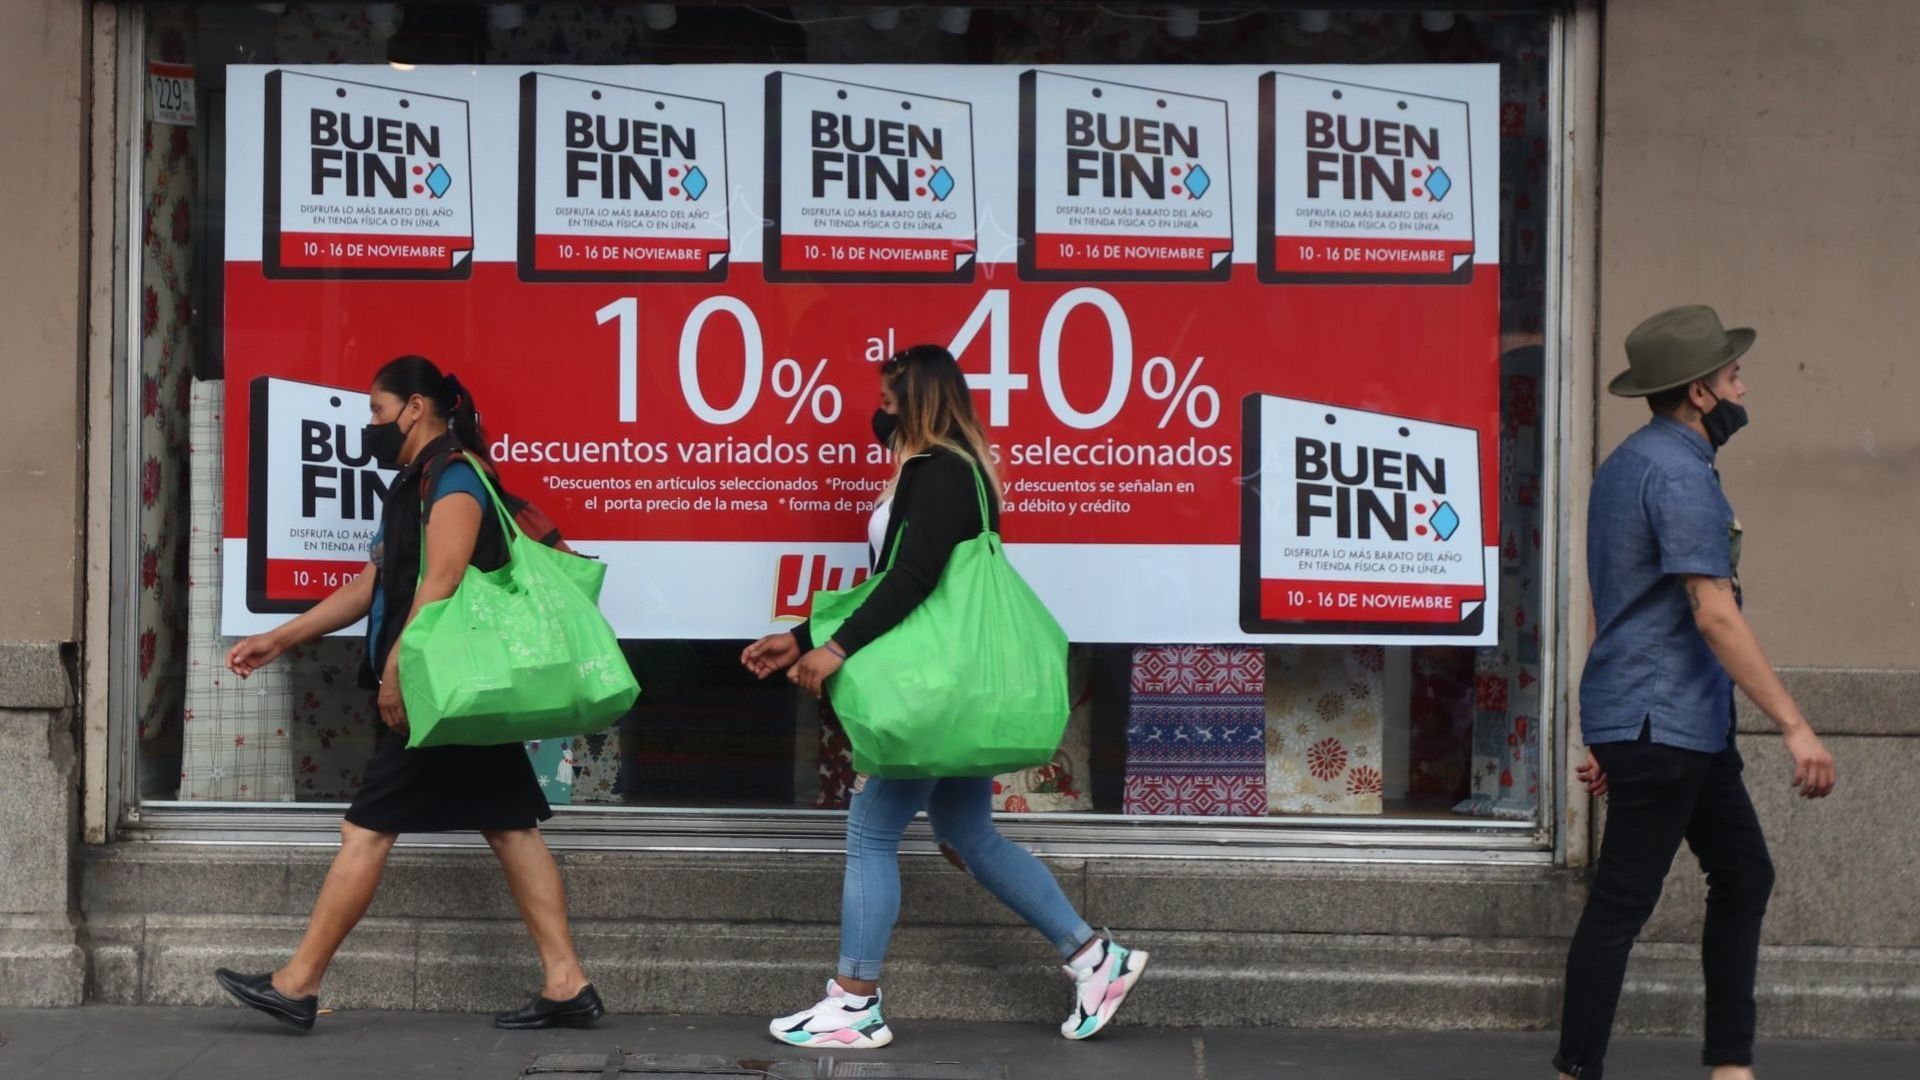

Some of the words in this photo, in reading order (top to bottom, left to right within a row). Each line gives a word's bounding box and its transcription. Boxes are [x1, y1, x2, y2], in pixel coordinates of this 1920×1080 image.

[311, 108, 440, 158] BUEN
[566, 110, 695, 160] BUEN
[812, 110, 942, 160] BUEN
[1067, 108, 1198, 158] BUEN
[1306, 110, 1439, 160] BUEN
[311, 148, 406, 198] FIN
[566, 150, 662, 201] FIN
[812, 150, 909, 201] FIN
[1067, 148, 1164, 199] FIN
[1307, 150, 1405, 202] FIN
[301, 205, 339, 214] DISFRUTA
[343, 206, 353, 214] LO
[356, 205, 376, 215] MÁS
[379, 207, 412, 216] BARATO
[415, 208, 429, 216] DEL
[432, 207, 453, 217] AÑO
[556, 208, 594, 216] DISFRUTA
[598, 209, 608, 217] LO
[612, 207, 631, 217] MÁS
[634, 209, 668, 218] BARATO
[671, 210, 685, 219] DEL
[688, 209, 709, 219] AÑO
[802, 208, 840, 217] DISFRUTA
[844, 209, 855, 217] LO
[858, 207, 878, 218] MÁS
[881, 210, 914, 219] BARATO
[918, 211, 932, 219] DEL
[935, 210, 956, 220] AÑO
[1056, 206, 1095, 215] DISFRUTA
[1099, 207, 1110, 215] LO
[1113, 206, 1133, 216] MÁS
[1136, 208, 1170, 217] BARATO
[1173, 209, 1187, 217] DEL
[1191, 208, 1212, 218] AÑO
[1296, 209, 1336, 217] DISFRUTA
[1339, 209, 1350, 218] LO
[1354, 208, 1373, 218] MÁS
[1377, 210, 1411, 219] BARATO
[1414, 211, 1428, 220] DEL
[1432, 210, 1453, 220] AÑO
[314, 216, 325, 224] EN
[329, 216, 358, 225] TIENDA
[362, 216, 387, 226] FÍSICA
[391, 218, 398, 226] O
[416, 218, 439, 227] LÍNEA
[569, 219, 580, 227] EN
[584, 219, 613, 227] TIENDA
[617, 218, 643, 228] FÍSICA
[657, 221, 668, 229] EN
[671, 220, 695, 229] LÍNEA
[815, 219, 826, 227] EN
[830, 219, 859, 228] TIENDA
[863, 218, 889, 229] FÍSICA
[893, 221, 900, 229] O
[918, 220, 942, 230] LÍNEA
[1070, 217, 1081, 225] EN
[1085, 217, 1115, 226] TIENDA
[1118, 217, 1145, 227] FÍSICA
[1159, 220, 1170, 228] EN
[1174, 219, 1198, 228] LÍNEA
[1310, 220, 1321, 228] EN
[1325, 220, 1355, 229] TIENDA
[1359, 219, 1385, 229] FÍSICA
[1389, 222, 1396, 230] O
[1400, 222, 1411, 230] EN
[1415, 221, 1439, 231] LÍNEA
[304, 242, 318, 256] 10
[330, 243, 343, 256] 16
[347, 244, 363, 256] DE
[368, 245, 445, 257] NOVIEMBRE
[559, 245, 573, 259] 10
[585, 246, 598, 259] 16
[603, 247, 618, 259] DE
[624, 248, 701, 260] NOVIEMBRE
[805, 245, 819, 259] 10
[831, 246, 844, 259] 16
[849, 247, 865, 260] DE
[870, 248, 948, 260] NOVIEMBRE
[1060, 244, 1074, 258] 10
[1086, 245, 1099, 258] 16
[1104, 245, 1120, 258] DE
[1125, 246, 1204, 259] NOVIEMBRE
[1300, 246, 1314, 260] 10
[1326, 247, 1340, 260] 16
[1344, 248, 1361, 261] DE
[1366, 249, 1445, 261] NOVIEMBRE
[865, 328, 895, 361] al
[490, 433, 668, 463] descuentos
[677, 434, 809, 464] variados
[818, 442, 857, 464] en
[1010, 436, 1233, 466] seleccionados
[1296, 437, 1446, 494] BUEN
[634, 479, 652, 490] en
[656, 476, 716, 490] artículos
[720, 477, 818, 491] seleccionados
[1002, 482, 1012, 494] y
[1015, 478, 1096, 492] descuentos
[1100, 482, 1115, 492] se
[1118, 479, 1173, 492] señalan
[1177, 482, 1194, 492] en
[584, 496, 597, 509] el
[605, 498, 642, 512] porta
[647, 497, 690, 512] precio
[694, 497, 711, 510] de
[715, 497, 727, 510] la
[731, 500, 768, 510] mesa
[789, 498, 830, 511] forma
[834, 498, 852, 511] de
[1018, 499, 1065, 512] débito
[1069, 502, 1077, 515] y
[1080, 499, 1131, 513] crédito
[1296, 482, 1407, 541] FIN
[290, 529, 333, 539] DISFRUTA
[337, 530, 349, 539] LO
[353, 529, 375, 540] MÁS
[305, 541, 317, 550] EN
[322, 541, 355, 551] TIENDA
[1284, 548, 1329, 558] DISFRUTA
[1333, 549, 1345, 559] LO
[1349, 548, 1371, 560] MÁS
[1375, 551, 1414, 561] BARATO
[1417, 552, 1434, 562] DEL
[1437, 551, 1462, 563] AÑO
[1299, 561, 1312, 570] EN
[1317, 561, 1351, 571] TIENDA
[1355, 561, 1385, 572] FÍSICA
[1389, 564, 1397, 573] O
[1401, 565, 1414, 573] EN
[1418, 563, 1446, 574] LÍNEA
[294, 571, 309, 586] 10
[323, 572, 337, 587] 16
[1288, 591, 1304, 607] 10
[1318, 592, 1333, 607] 16
[1339, 593, 1357, 608] DE
[1363, 595, 1453, 609] NOVIEMBRE
